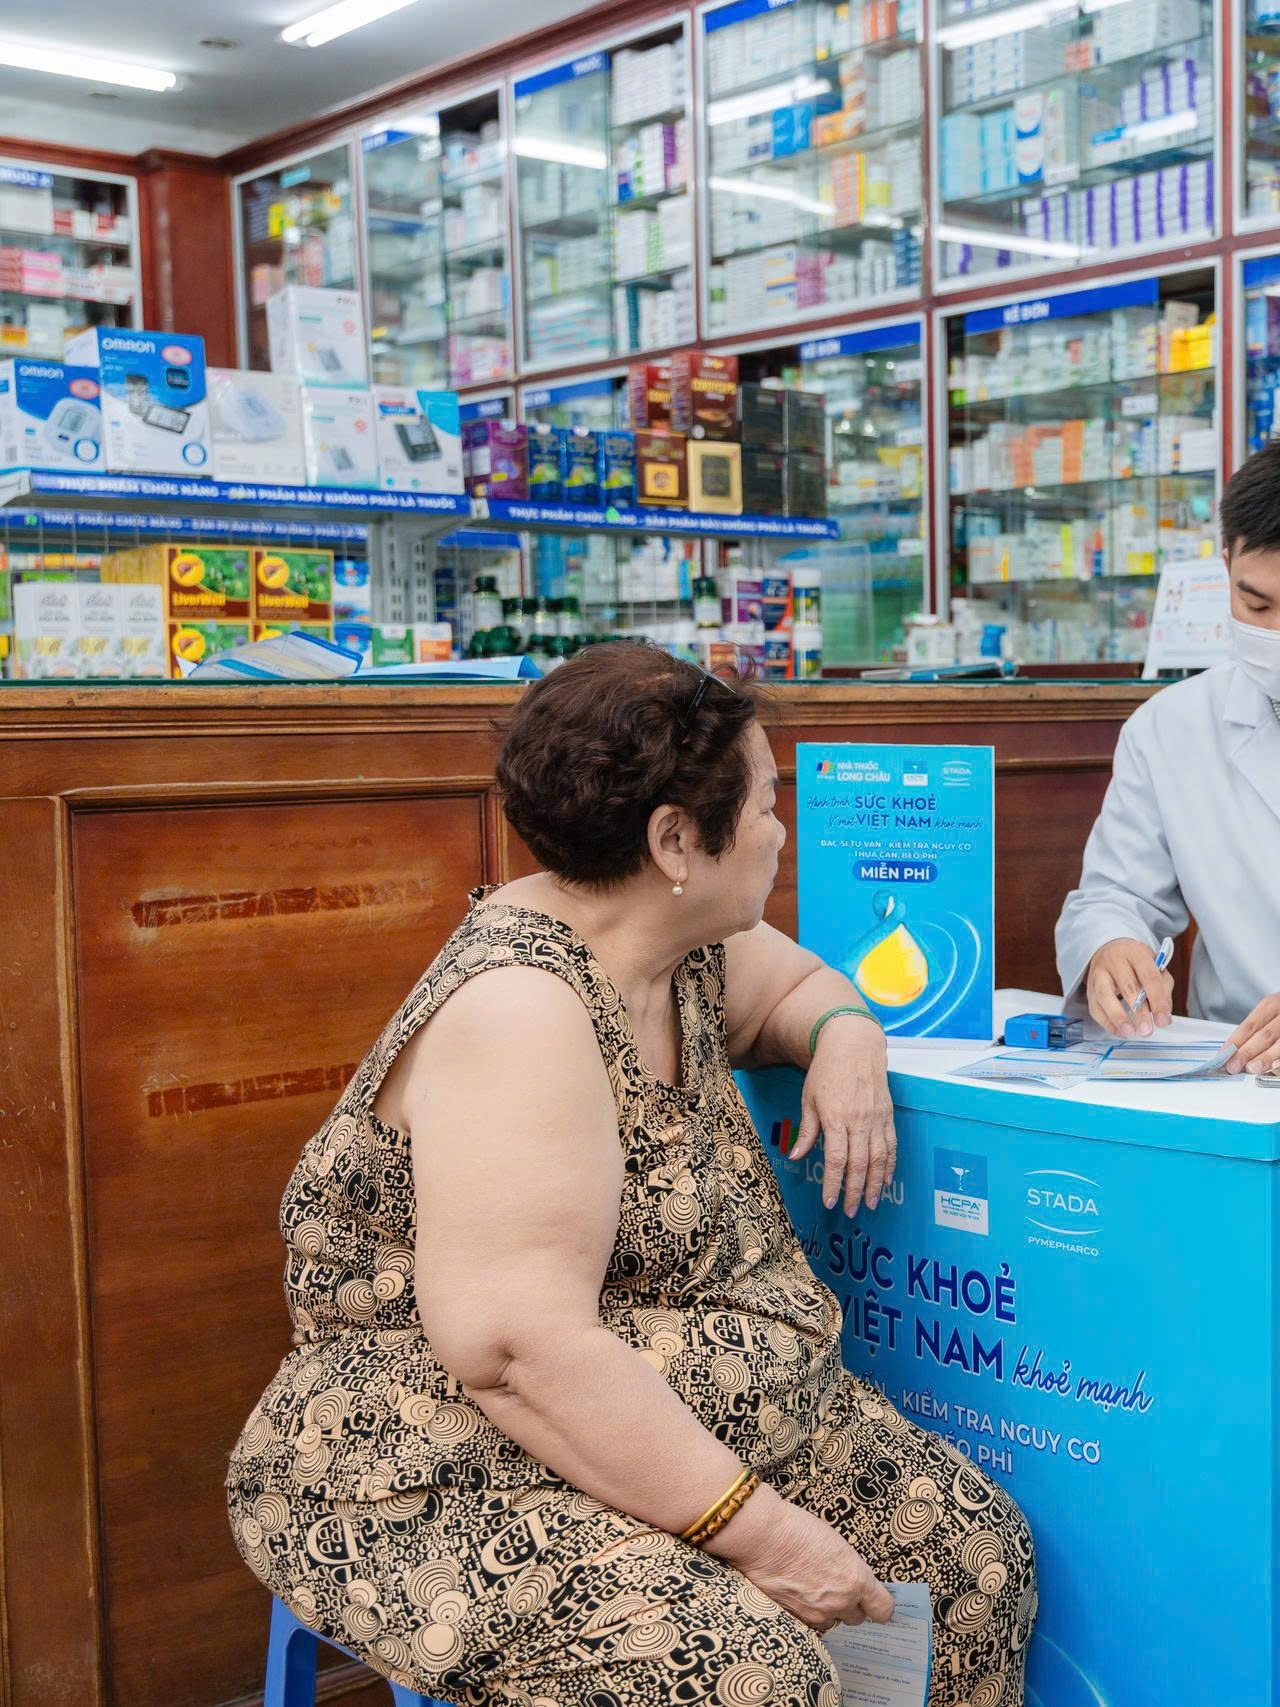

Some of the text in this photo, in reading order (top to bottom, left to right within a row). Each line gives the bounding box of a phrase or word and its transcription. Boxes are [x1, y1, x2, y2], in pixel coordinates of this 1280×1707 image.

[854, 760, 879, 771] THUỐC
[837, 772, 863, 782] LONG
[864, 771, 891, 783] CHÂU
[855, 792, 886, 810] SỨC
[856, 811, 890, 831] VIỆT
[895, 814, 932, 828] NAM
[861, 862, 930, 880] MIỄN PHÍ
[940, 1195, 980, 1211] HCPA
[1027, 1187, 1099, 1217] STADA
[1027, 1236, 1099, 1257] PYMEPHARCO
[828, 1227, 895, 1290] SỨC
[907, 1262, 1017, 1325] KHOẺ
[915, 1314, 1004, 1382] NAM
[1012, 1345, 1072, 1395] khoẻ
[1075, 1370, 1154, 1413] mạnh
[953, 1404, 995, 1437] TRA
[1000, 1417, 1062, 1456] NGUY
[1066, 1438, 1101, 1466] CƠ
[978, 1446, 1013, 1474] PHÌ
